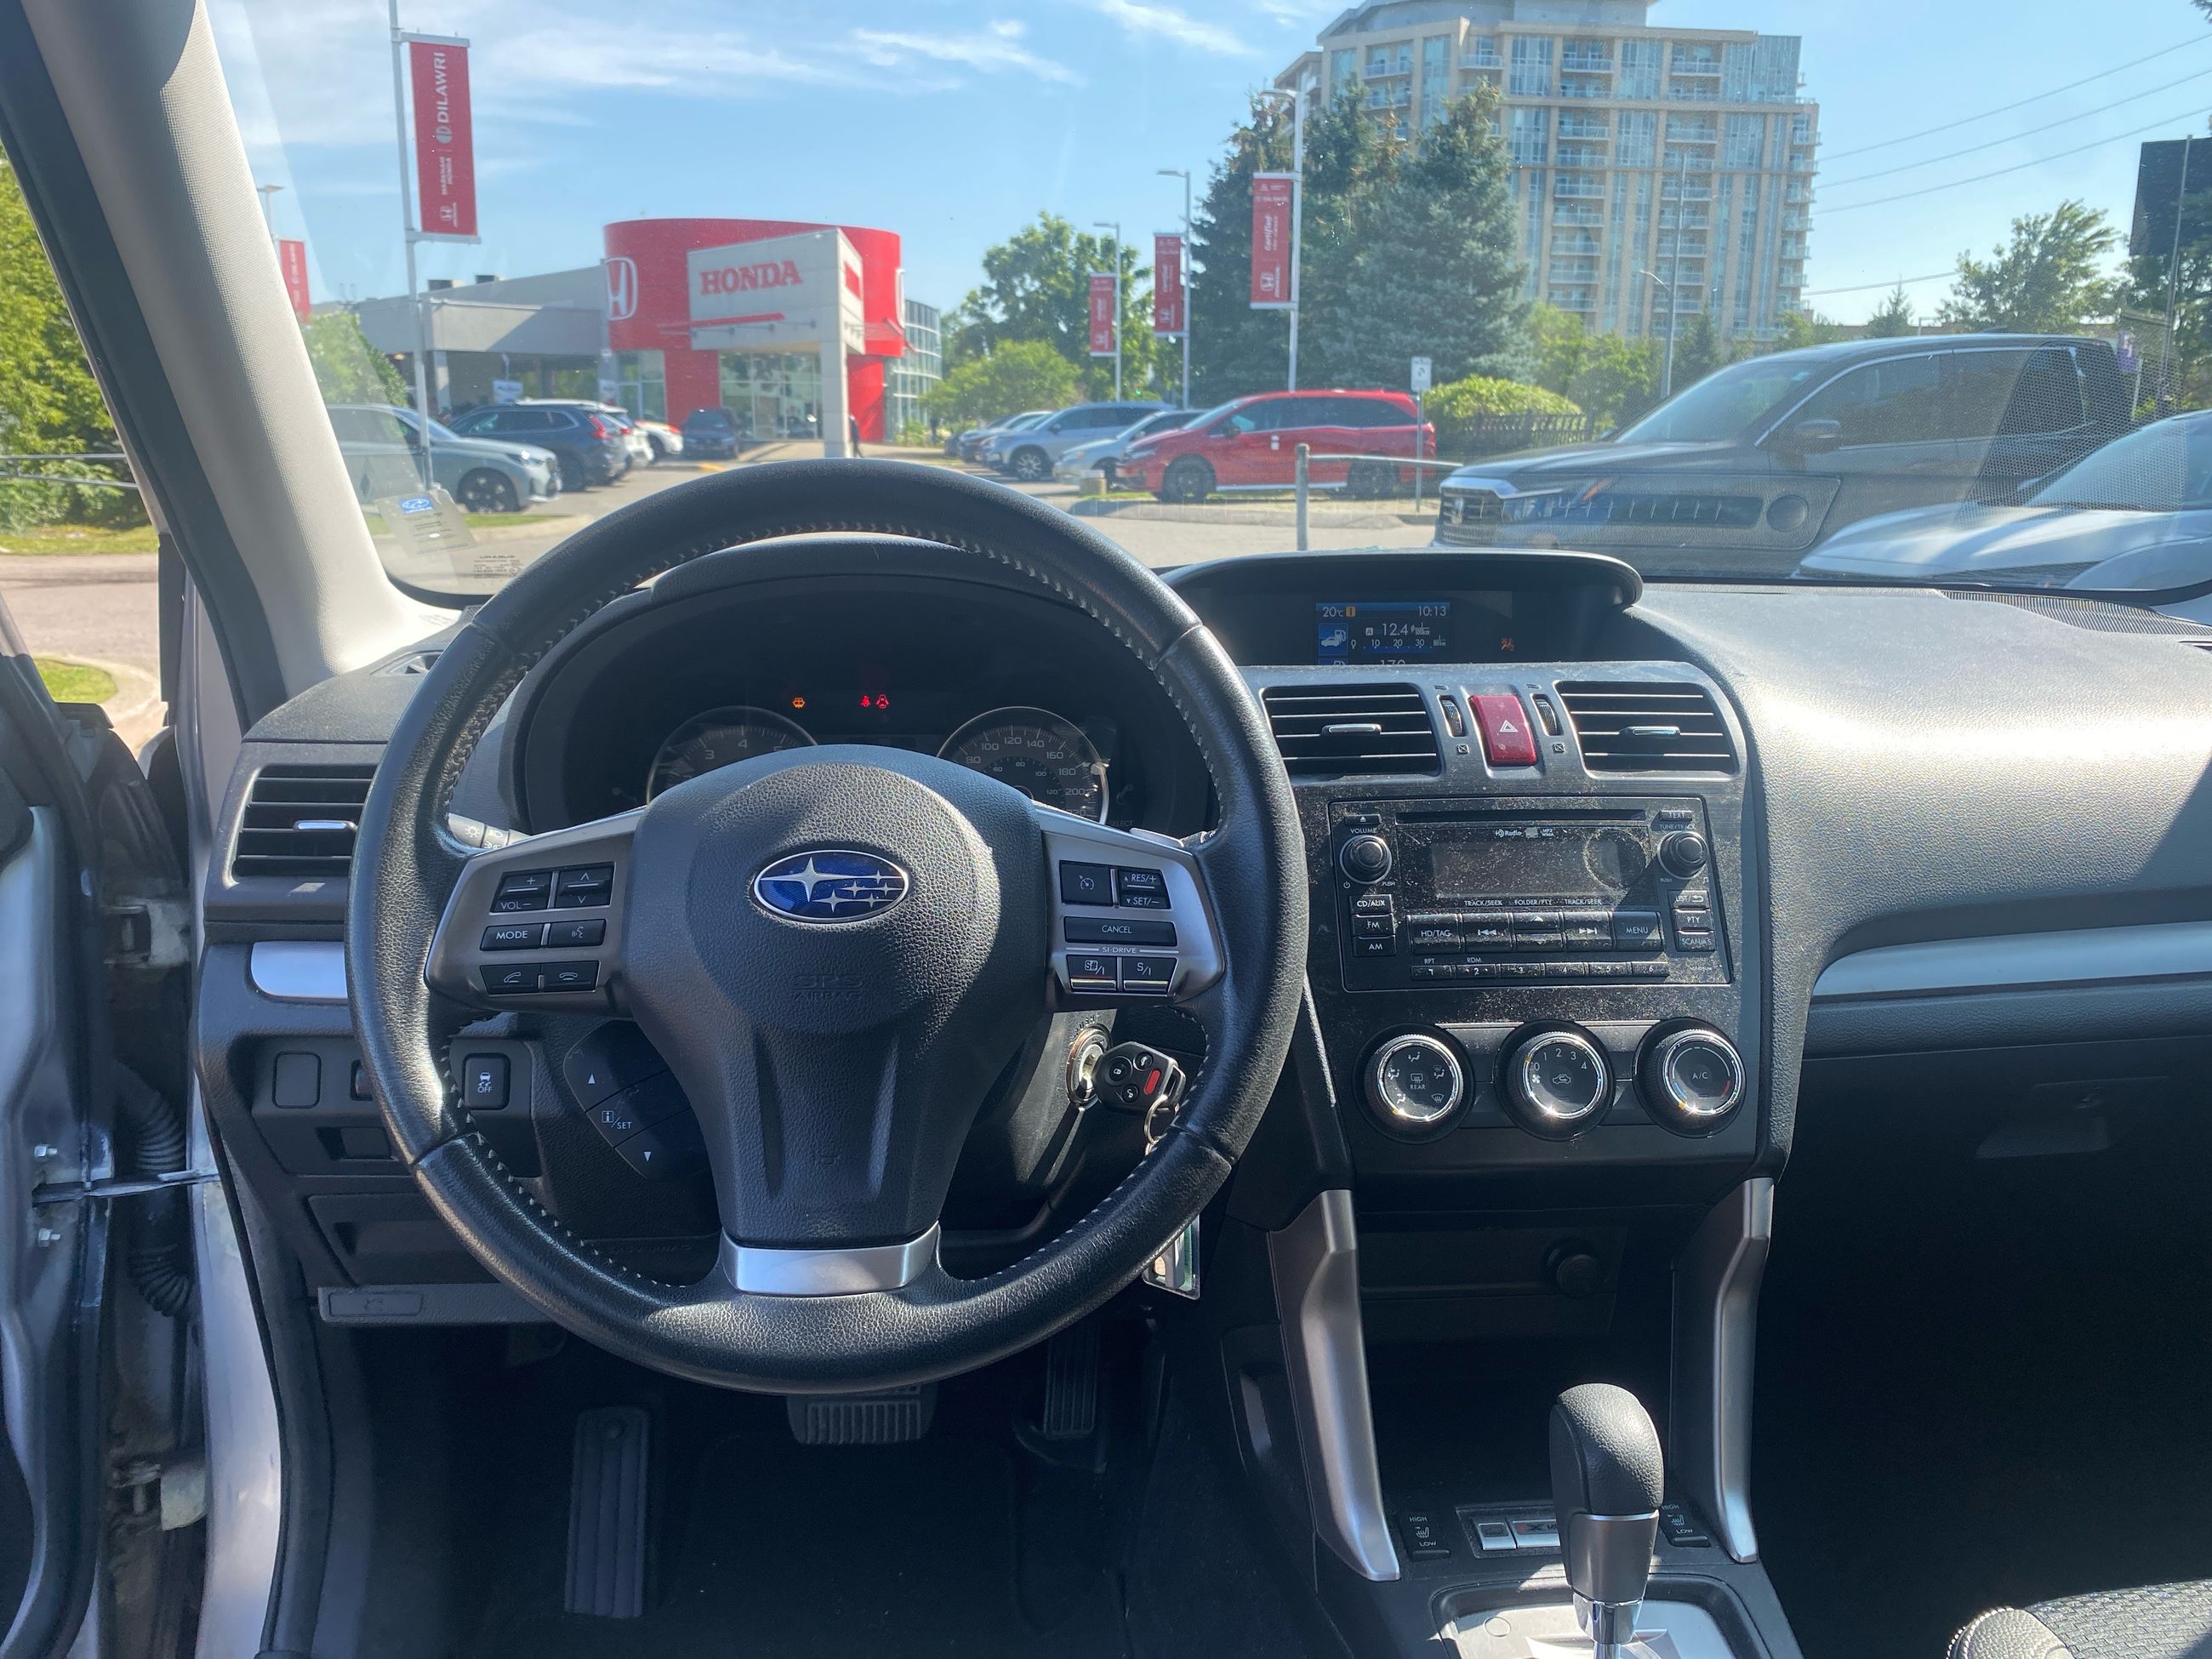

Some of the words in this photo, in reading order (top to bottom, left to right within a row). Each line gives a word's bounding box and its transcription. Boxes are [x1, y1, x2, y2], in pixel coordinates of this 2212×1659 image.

[433, 51, 450, 123] DILAWRI
[699, 259, 803, 296] HONDA
[1417, 606, 1446, 617] 10:13
[1382, 623, 1409, 636] 12.4
[1393, 638, 1403, 647] 20
[1415, 638, 1424, 647] 30
[738, 738, 748, 749] 4
[1004, 737, 1022, 745] 120
[981, 743, 999, 751] 100
[704, 750, 715, 760] 3
[1046, 751, 1063, 760] 160
[1058, 767, 1076, 776] 180
[1065, 788, 1086, 796] 200
[1101, 925, 1132, 934] CANCEL
[495, 930, 529, 940] MODE
[1533, 1062, 1541, 1071] 0
[1555, 1048, 1562, 1057] 2
[1570, 1052, 1576, 1060] 3
[1581, 1062, 1588, 1070] 4
[1691, 1070, 1708, 1080] A/C
